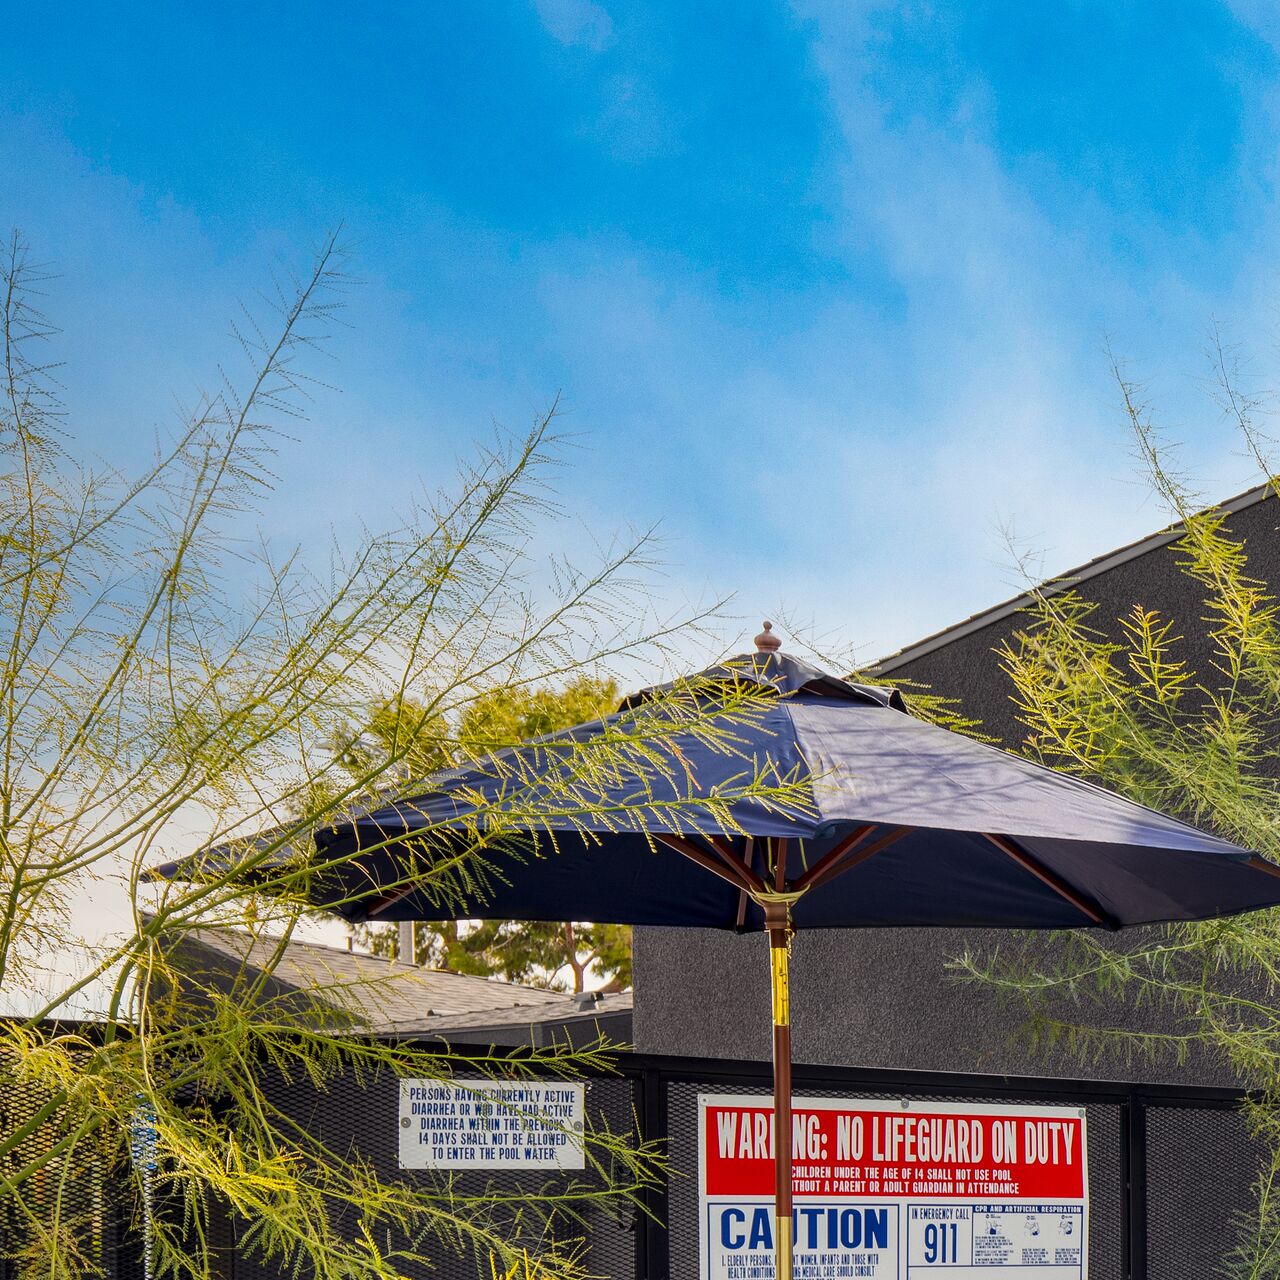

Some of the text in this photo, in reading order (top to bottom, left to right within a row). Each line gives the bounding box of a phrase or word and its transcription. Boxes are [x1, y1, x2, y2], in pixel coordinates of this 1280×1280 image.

[410, 1088, 575, 1102] PERSONS HAVING CURRENTLY ACTIVE
[411, 1103, 573, 1117] DIARRHEA OR WHO HAVE HAD ACTIVE
[421, 1118, 565, 1131] DIARRHEA WITHIN THE PREVIOUS
[419, 1132, 566, 1146] 14 DAYS SHALL NOT BE ALLOWED
[716, 1112, 1075, 1165] WARNG: NO LIFEGUARD ON DUTY
[432, 1147, 555, 1160] TO ENTER THE POOL WATER
[791, 1166, 1012, 1181] CHILDREN UNDER THE AGE OF 14 SHALL NOT USE POOL
[791, 1180, 1019, 1194] ITHOUT A PARENT OR ADULT GUARDIAN IN ATTENDANCE
[911, 1208, 970, 1220] IN EMERGENCY CALL
[1041, 1206, 1081, 1214] RESPIRATION
[720, 1208, 888, 1249] CATION
[924, 1223, 957, 1264] 911
[728, 1255, 748, 1266] ELDERLY
[820, 1254, 840, 1265] INFANTS
[841, 1254, 850, 1265] AND
[852, 1254, 866, 1265] THOSE
[868, 1254, 879, 1264] WITH
[728, 1267, 746, 1278] HEALTH
[747, 1267, 775, 1278] CONDITIONS
[802, 1266, 821, 1277] MEDICAL
[823, 1266, 835, 1277] CARE
[837, 1266, 853, 1277] SHOULD
[855, 1266, 875, 1276] CONSULT
